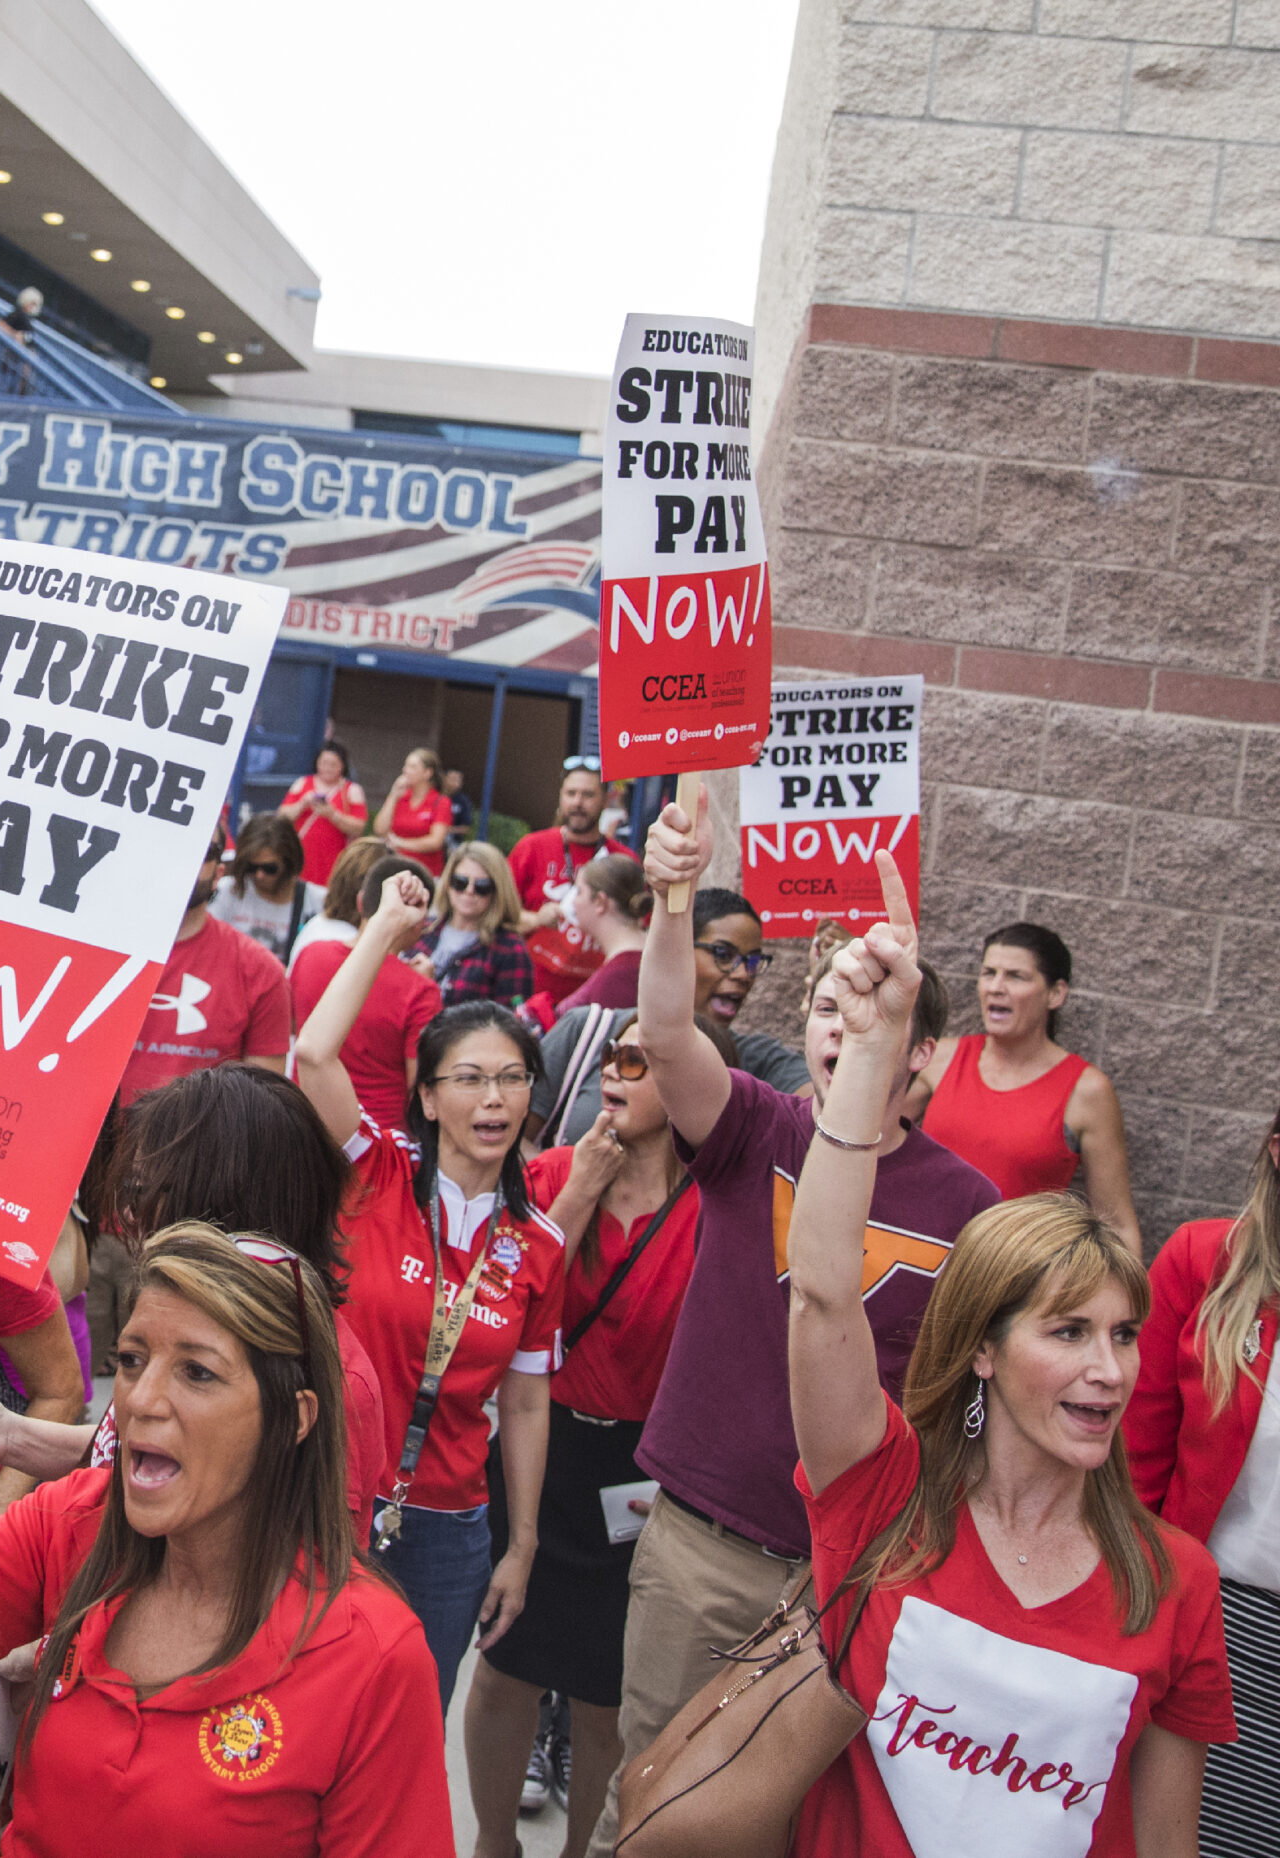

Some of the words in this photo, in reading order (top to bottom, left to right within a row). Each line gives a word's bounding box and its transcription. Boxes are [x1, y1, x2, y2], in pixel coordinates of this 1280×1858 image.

[642, 329, 737, 359] EDUCATORS
[738, 339, 748, 361] ON
[616, 367, 751, 429] STRIKE
[40, 414, 226, 506] HIGH
[240, 435, 528, 539] SCHOOL
[617, 440, 699, 480] FOR
[705, 443, 751, 482] MORE
[654, 495, 747, 554] PAY
[182, 594, 242, 635] ON
[610, 563, 765, 653] NOW!
[642, 674, 707, 701] CCEA
[878, 686, 903, 697] ON
[820, 742, 907, 765] MORE
[8, 726, 206, 826] MORE
[780, 774, 880, 808] PAY
[748, 814, 912, 868] NOW!
[778, 878, 837, 895] CCEA
[147, 1042, 219, 1059] ARMOUR
[446, 1302, 463, 1331] VEGAS
[255, 1694, 283, 1736] SCHORR
[198, 1717, 235, 1781] ELEMENTARY
[238, 1752, 279, 1781] SCHOOL
[871, 1694, 1108, 1811] Teacher
